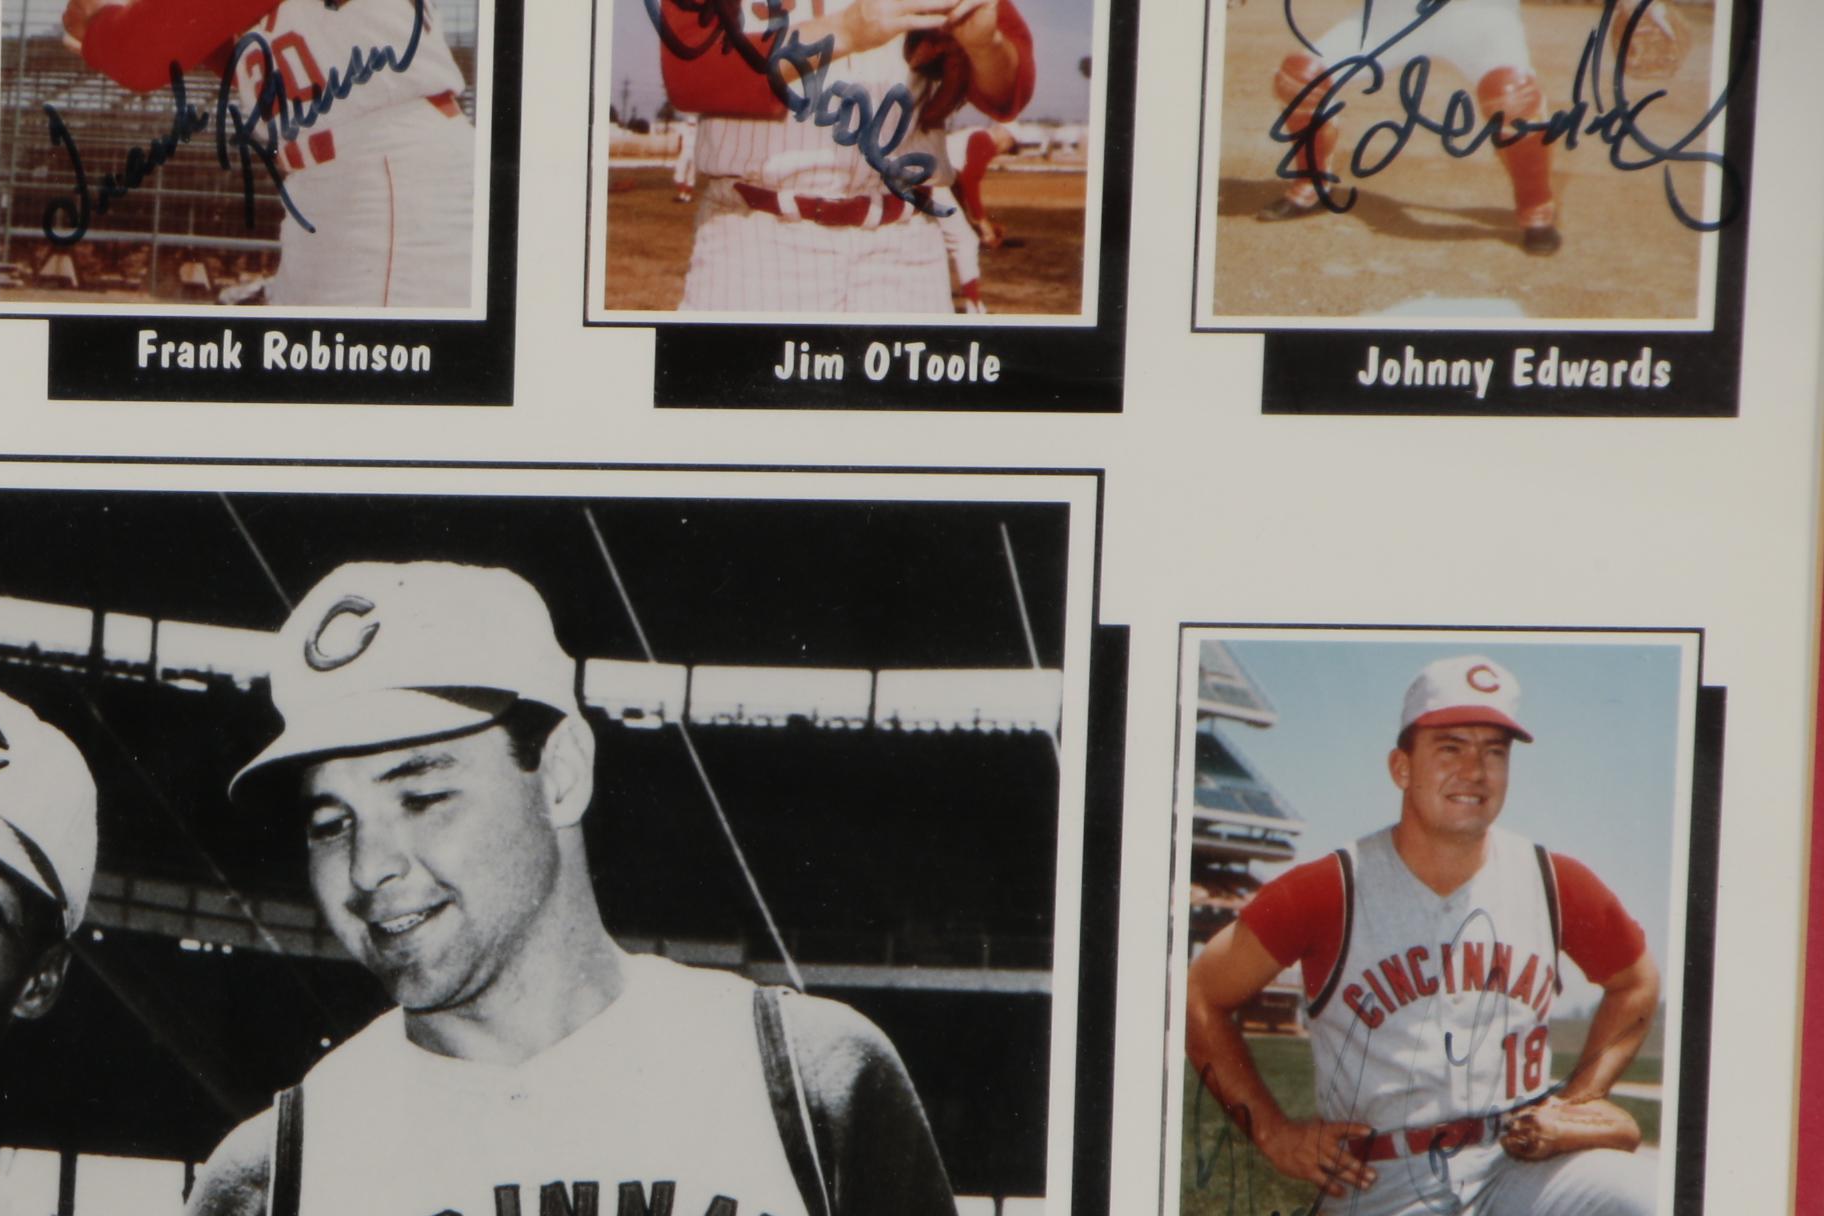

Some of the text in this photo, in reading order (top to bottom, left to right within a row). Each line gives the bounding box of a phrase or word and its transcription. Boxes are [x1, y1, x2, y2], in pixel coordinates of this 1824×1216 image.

[138, 329, 431, 372] Frank Robinson
[774, 340, 1001, 382] Jim O'Toole
[1357, 345, 1672, 399] Johnny Edwards
[302, 594, 380, 672] C
[1465, 663, 1500, 696] C
[1502, 1024, 1549, 1100] 18
